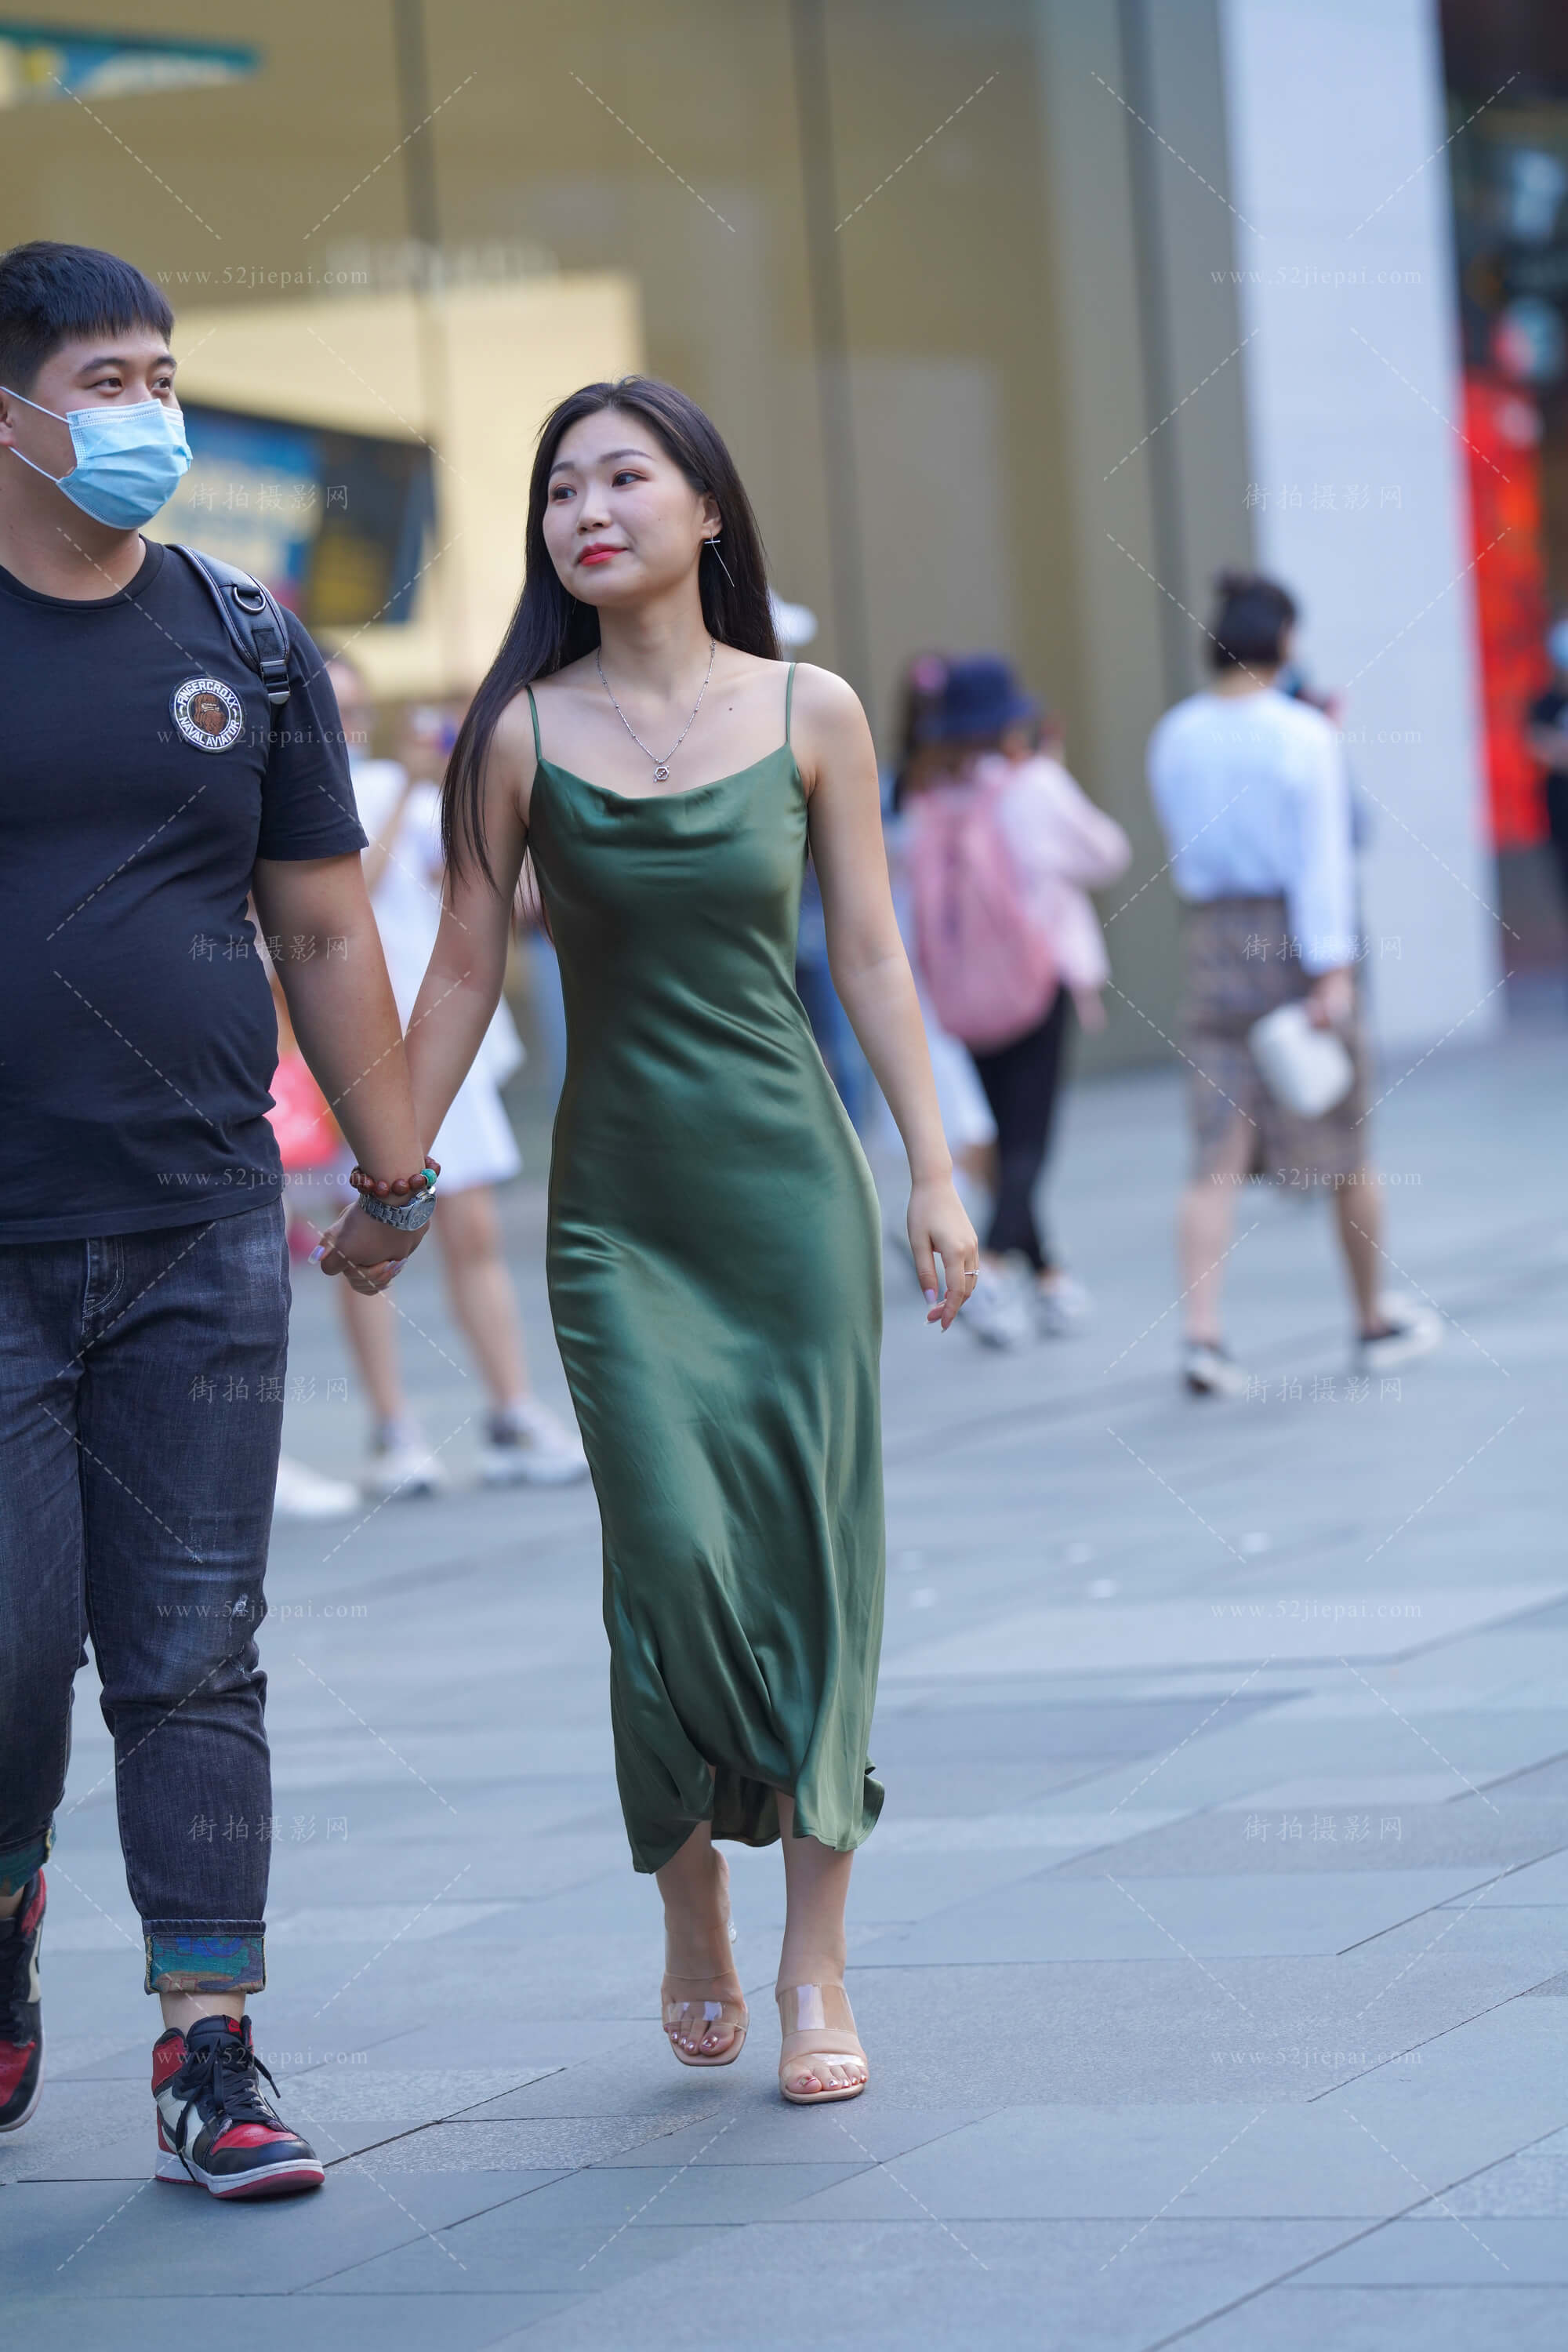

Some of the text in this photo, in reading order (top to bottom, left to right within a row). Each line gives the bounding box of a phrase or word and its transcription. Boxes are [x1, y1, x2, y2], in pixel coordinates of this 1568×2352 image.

[177, 681, 238, 708] FINGERCROXX
[179, 716, 239, 746] NAVAL AVIATOR
